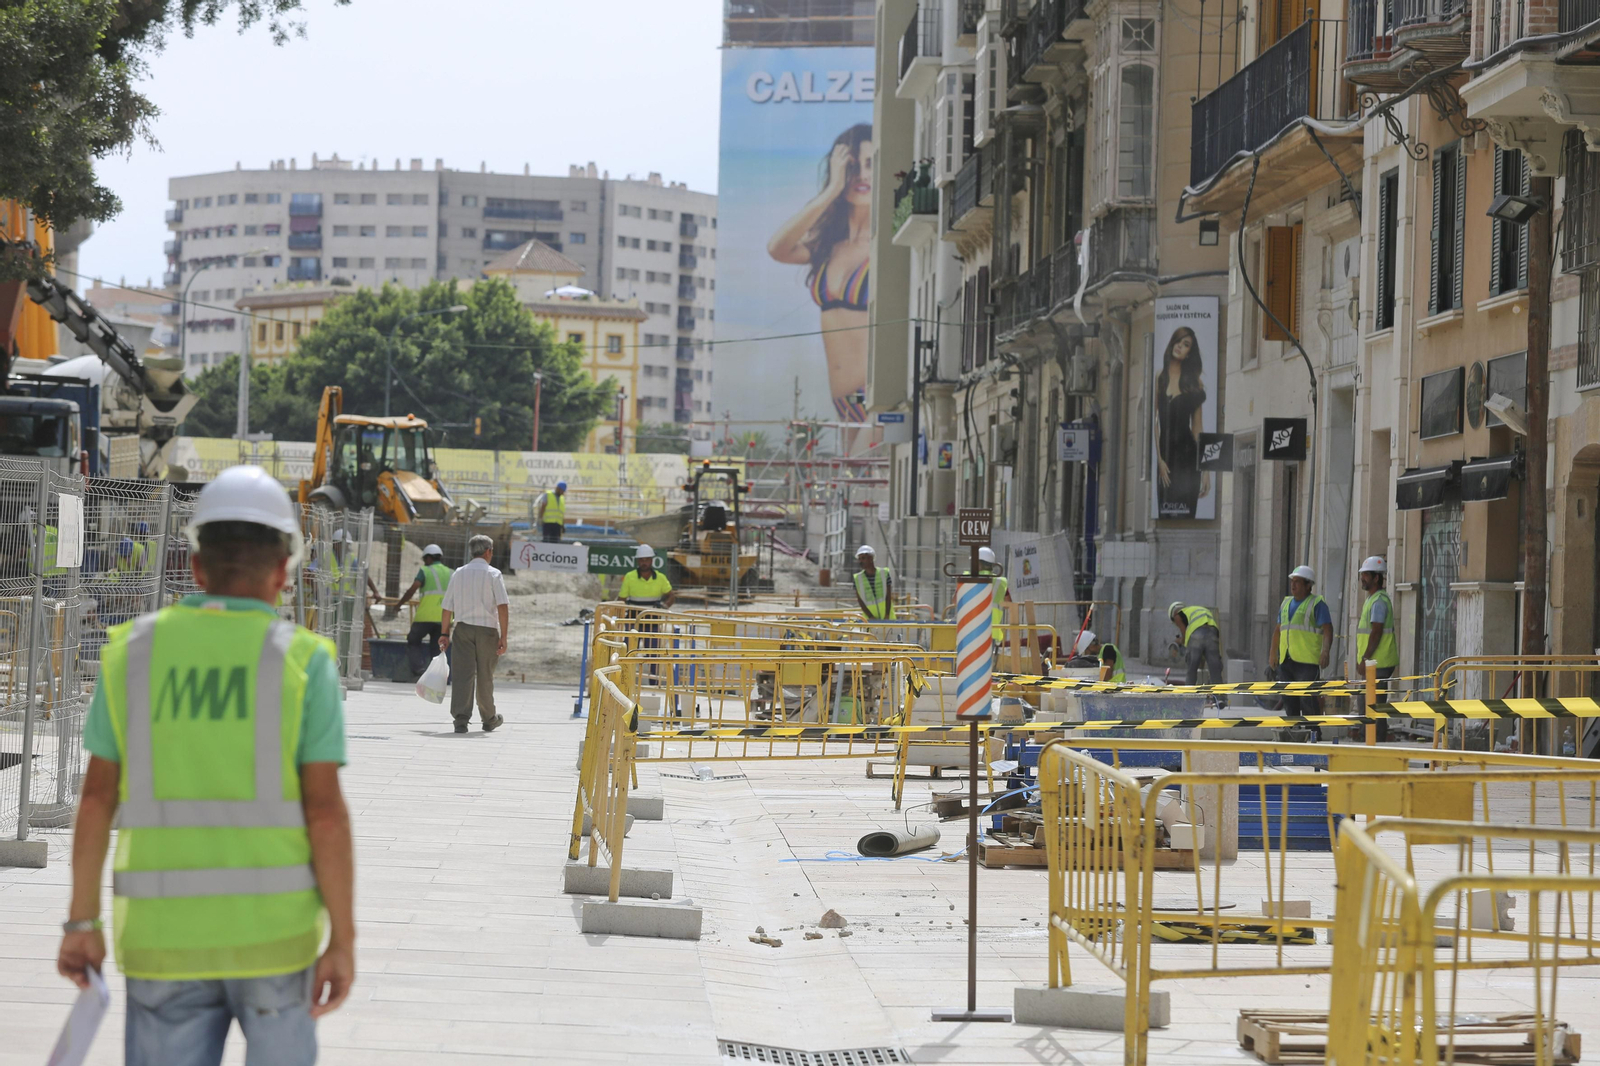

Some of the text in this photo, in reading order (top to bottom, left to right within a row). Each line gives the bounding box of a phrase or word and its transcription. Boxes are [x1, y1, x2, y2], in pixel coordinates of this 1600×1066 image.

[1166, 303, 1190, 311] SALÓN DE
[1271, 429, 1290, 450] AXO
[961, 520, 989, 536] CREW
[532, 551, 578, 565] acciona
[598, 554, 664, 569] SANO
